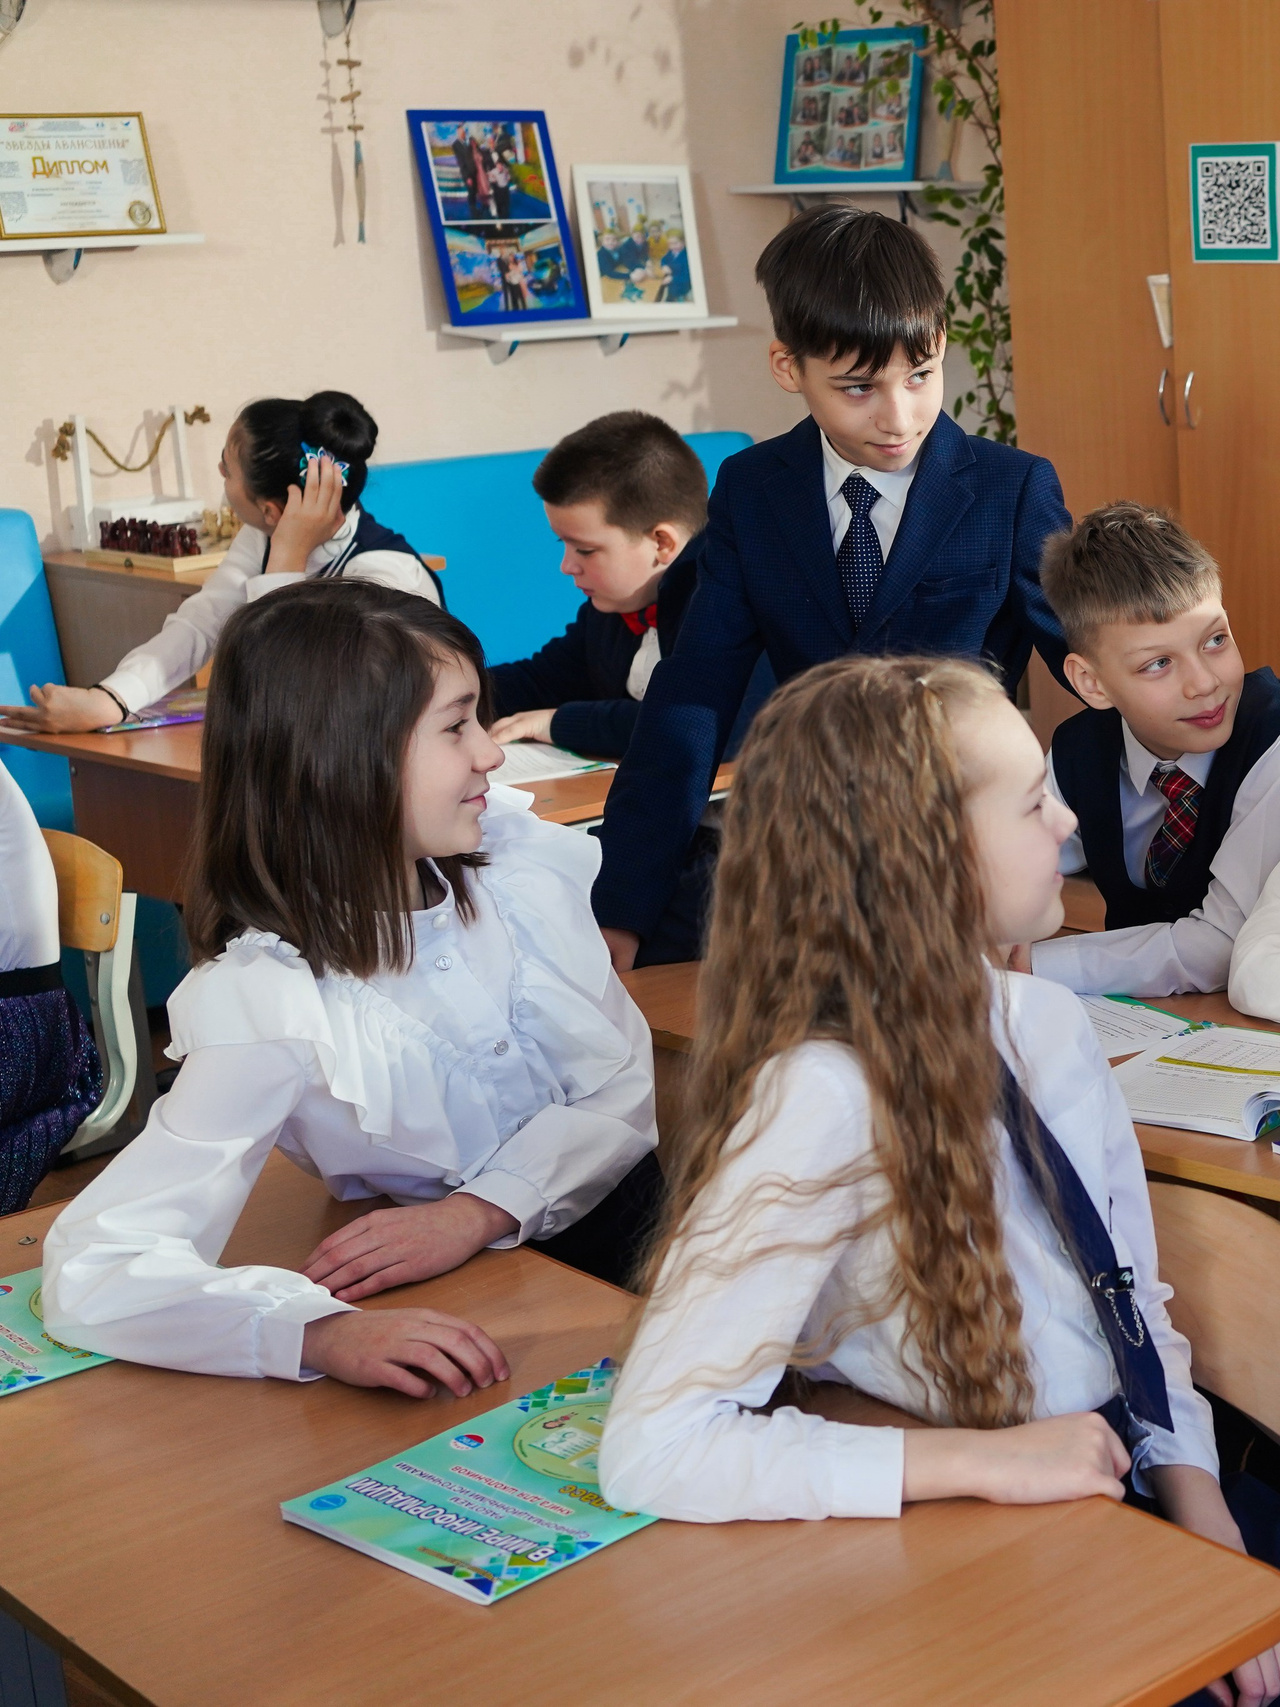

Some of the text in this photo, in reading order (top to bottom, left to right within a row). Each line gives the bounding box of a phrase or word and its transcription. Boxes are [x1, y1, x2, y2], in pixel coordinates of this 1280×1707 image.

[395, 1462, 470, 1496] ИСТОЧНИКАМИ
[451, 1465, 574, 1516] книга для школьников
[345, 1476, 558, 1562] В МИРЕ ИНФОРМАЦИИ
[449, 1496, 505, 1520] РАБОТАЕМ
